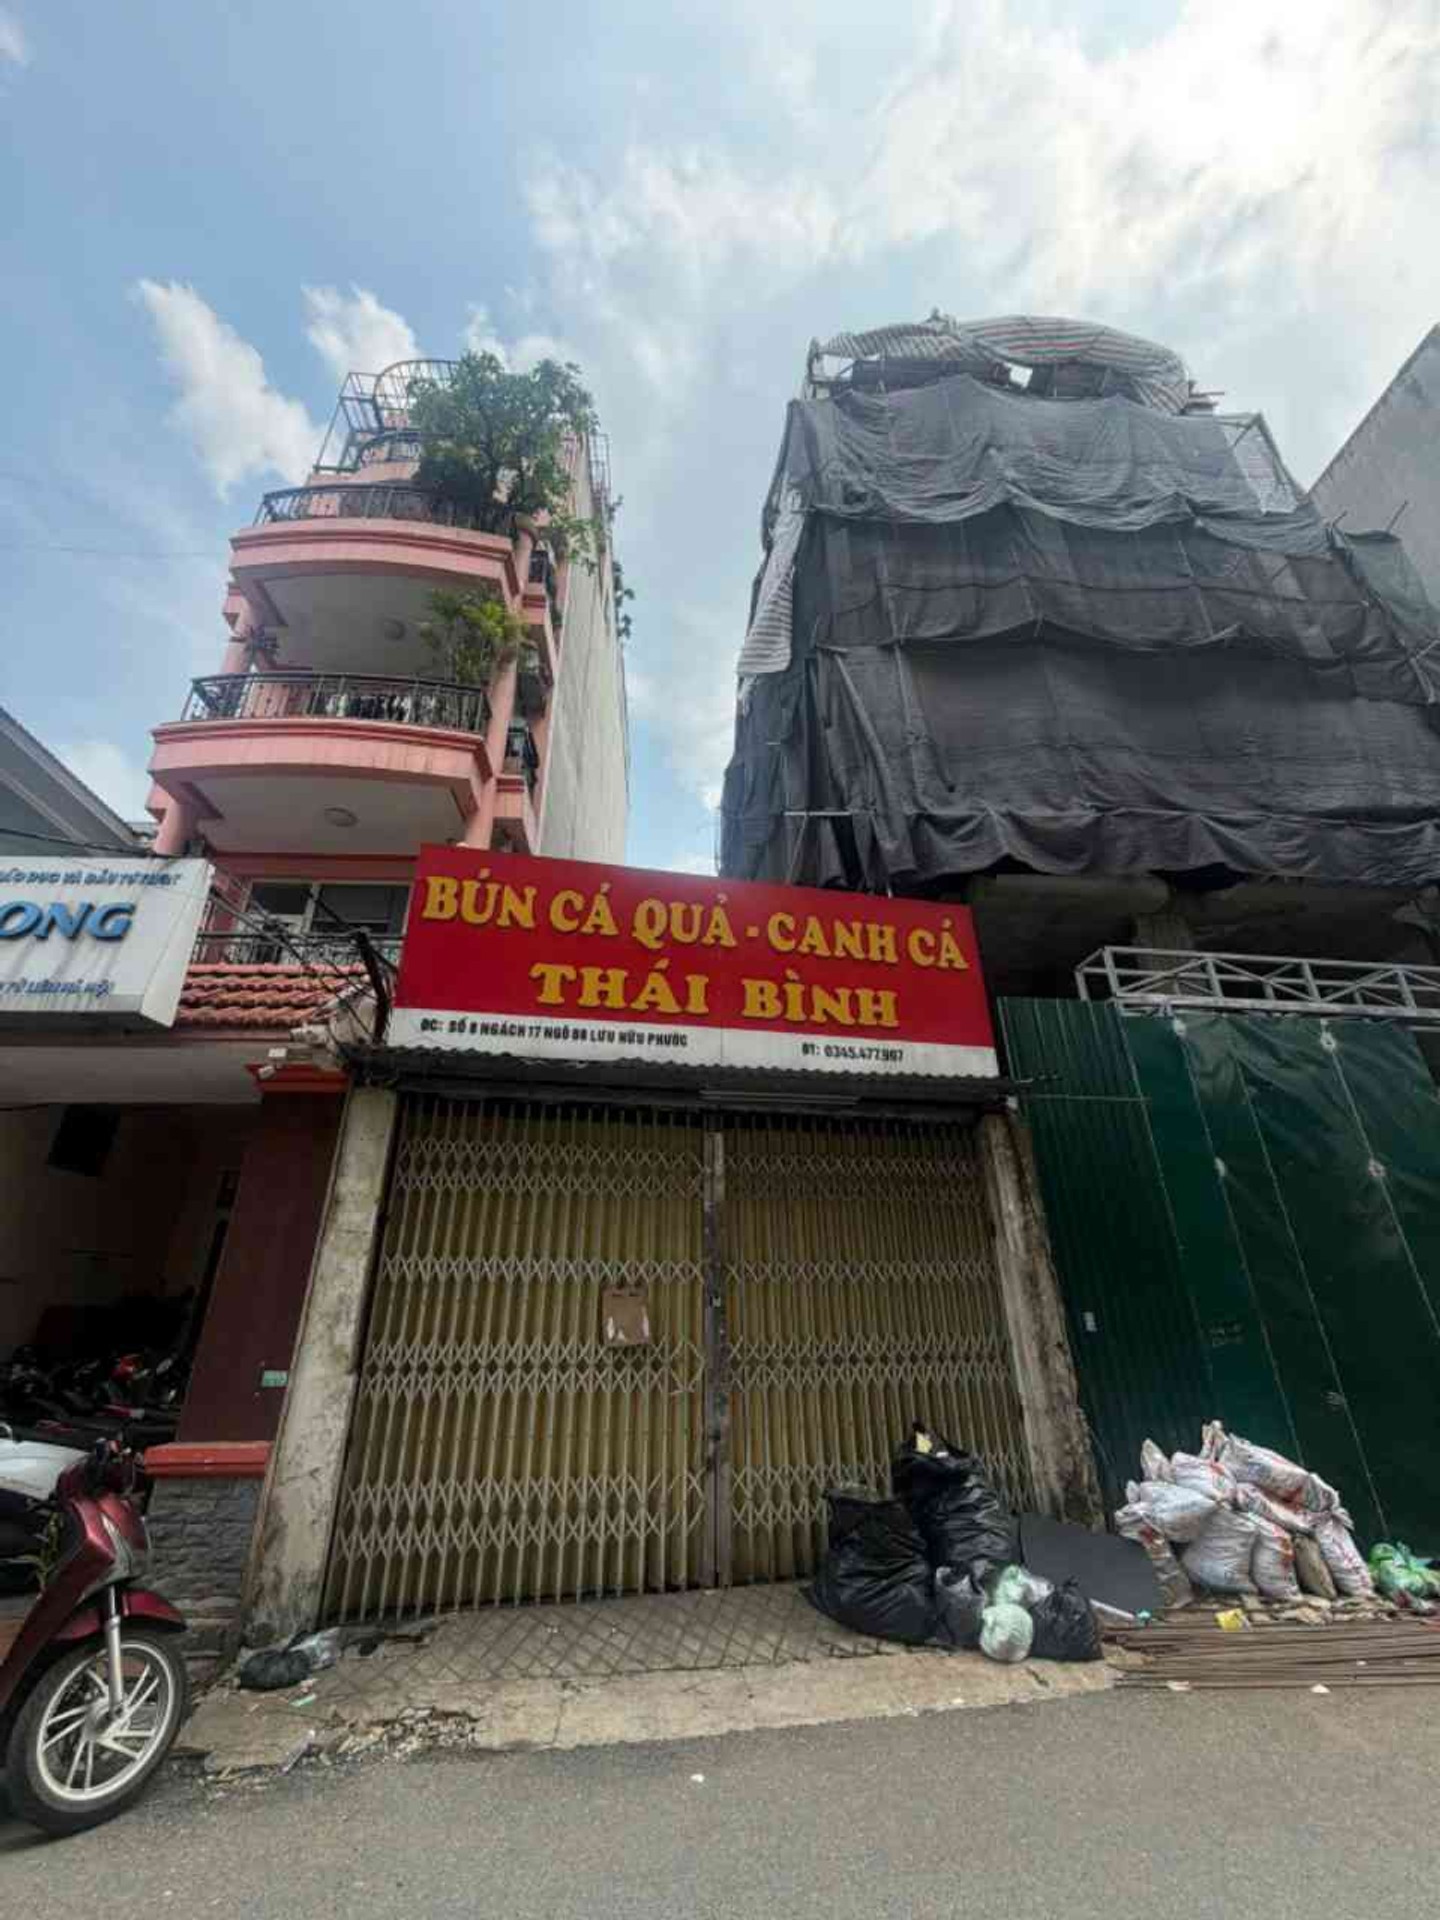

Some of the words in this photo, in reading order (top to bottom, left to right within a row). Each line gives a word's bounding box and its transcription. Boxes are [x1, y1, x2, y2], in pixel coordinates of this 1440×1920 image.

[422, 867, 537, 928] BÚN
[550, 883, 619, 936] CÁ
[632, 892, 738, 949] QUẢ
[767, 911, 898, 963] CANH
[908, 918, 970, 969] CÁ
[529, 957, 709, 1014] THÁI
[741, 968, 900, 1027] BÌNH
[448, 1017, 468, 1033] SỐ
[480, 1020, 525, 1036] NGÁCH
[527, 1025, 541, 1038] 17
